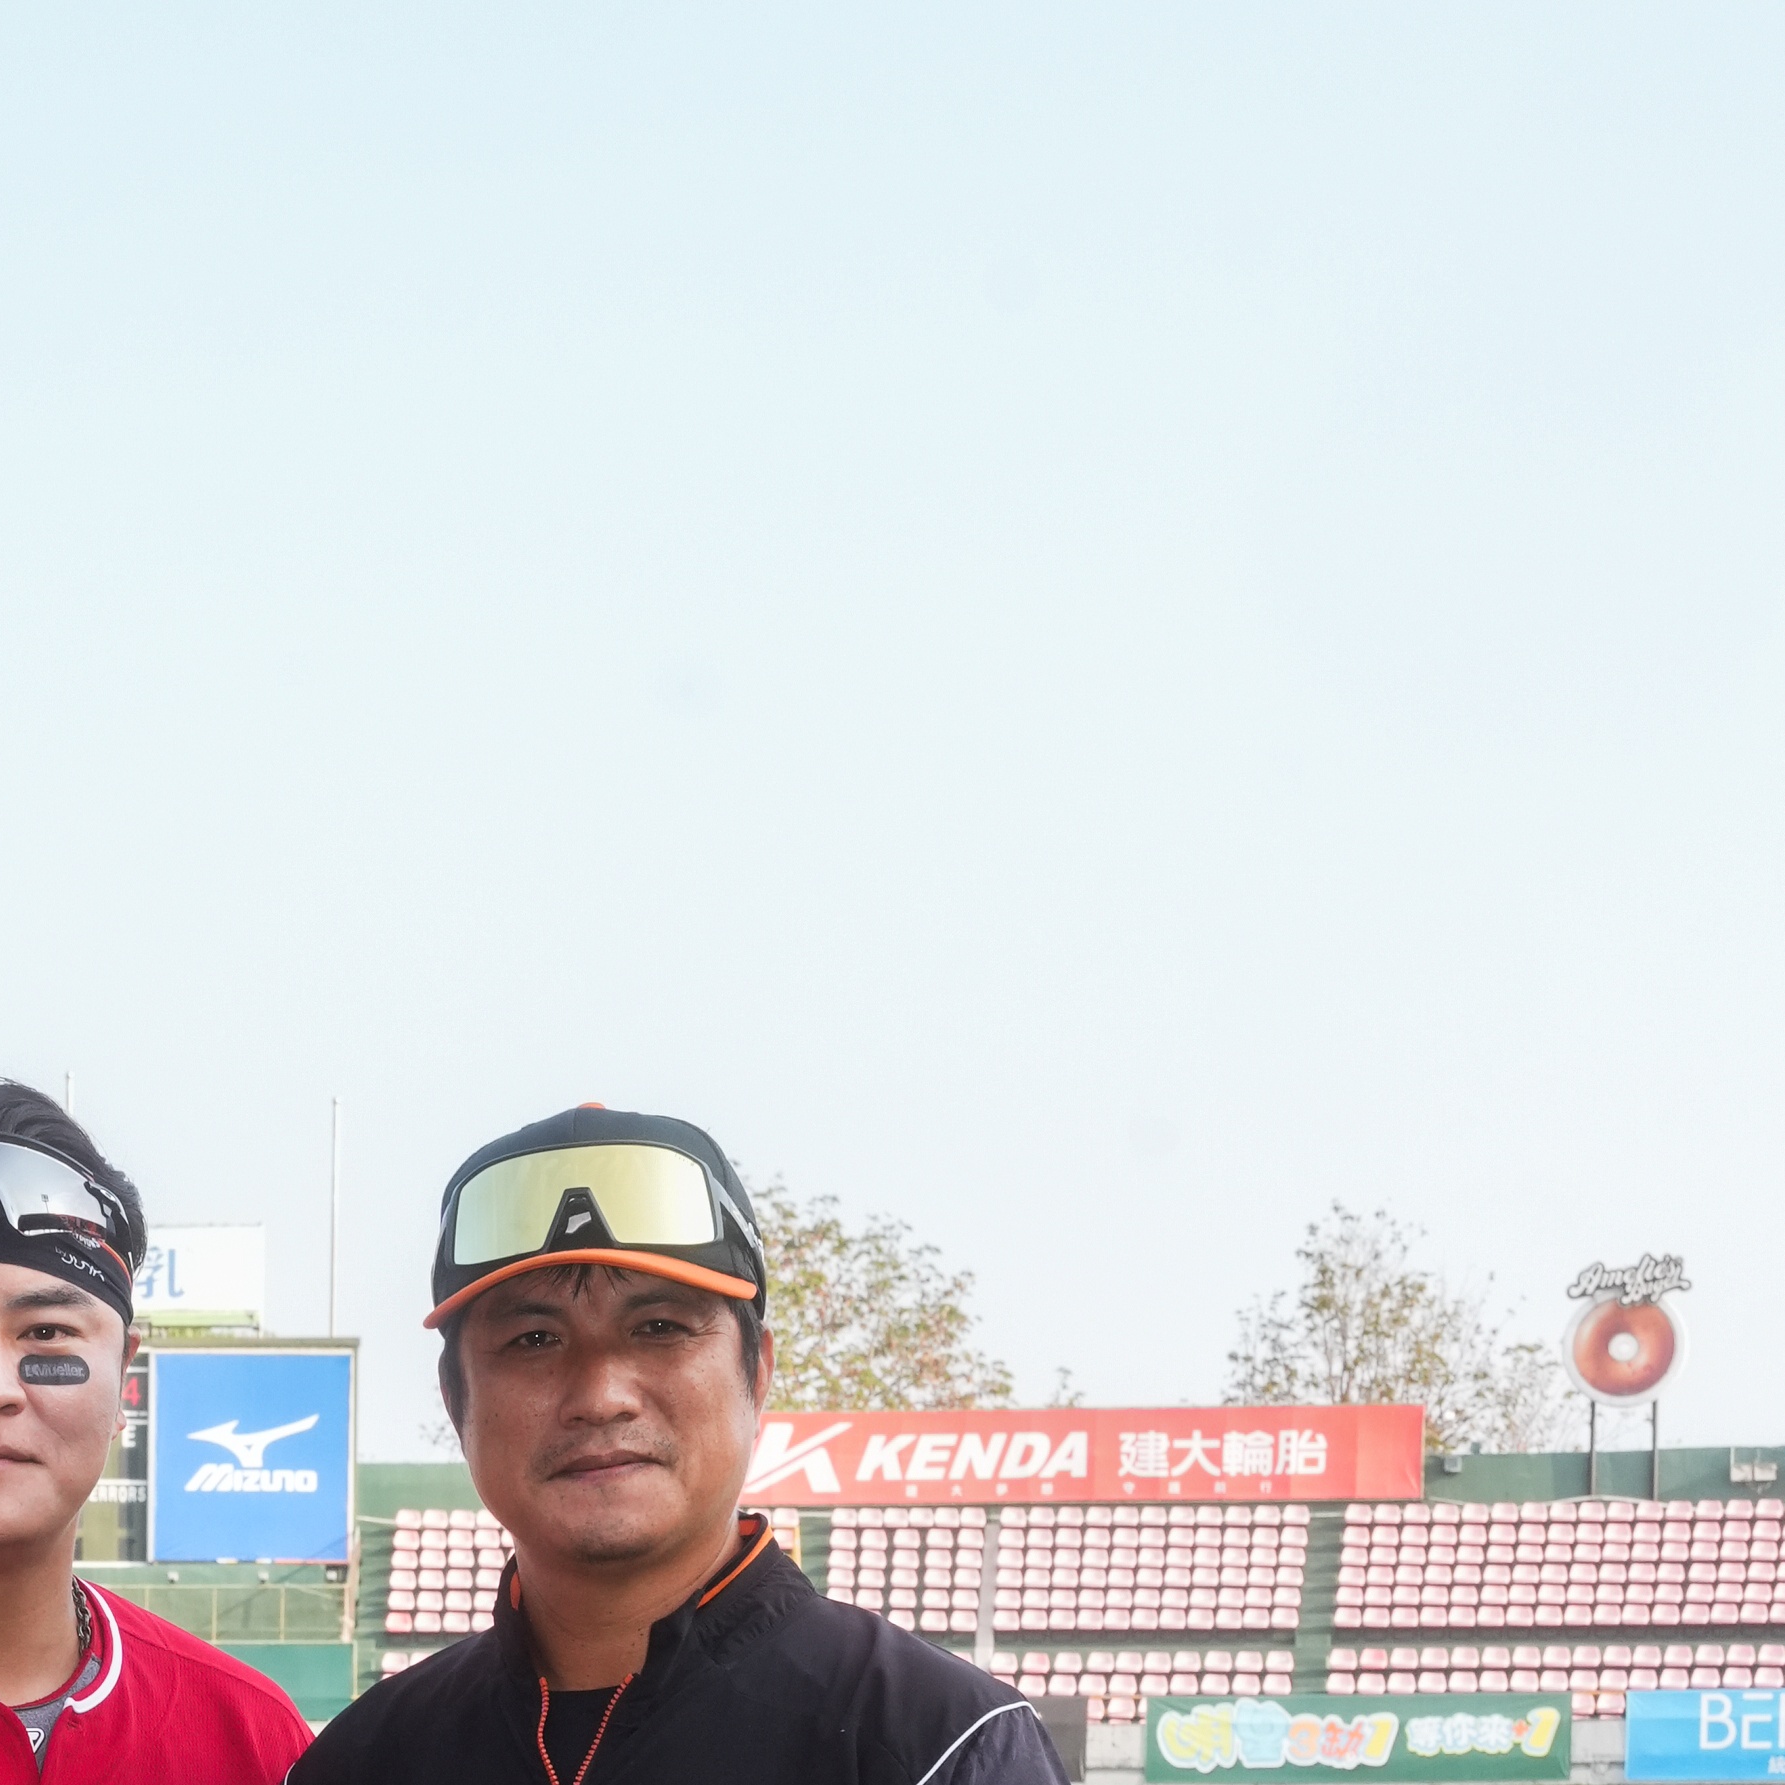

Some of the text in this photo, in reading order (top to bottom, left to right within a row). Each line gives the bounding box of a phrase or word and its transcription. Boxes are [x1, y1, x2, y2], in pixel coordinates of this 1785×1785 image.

[855, 1431, 1088, 1482] KENDA
[1118, 1429, 1327, 1478] 建大輪胎
[1699, 1692, 1785, 1751] BE
